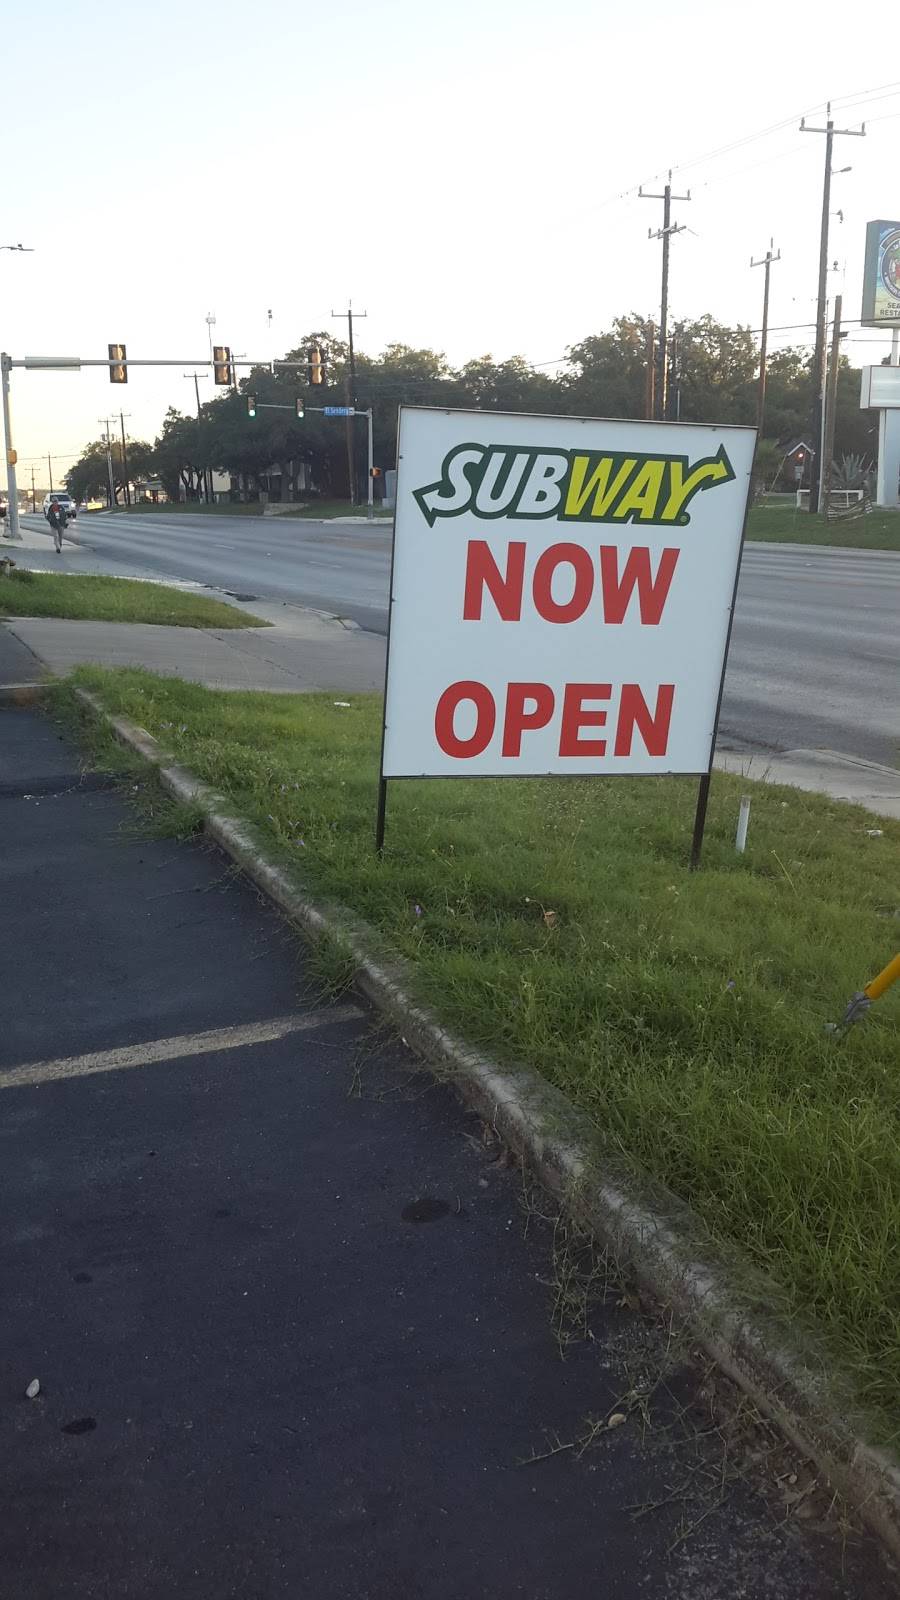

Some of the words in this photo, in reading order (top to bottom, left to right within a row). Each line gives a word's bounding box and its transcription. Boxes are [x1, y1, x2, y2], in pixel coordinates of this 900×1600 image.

[421, 447, 728, 521] SUBWAY
[463, 540, 679, 625] NOW
[435, 681, 675, 759] OPEN
